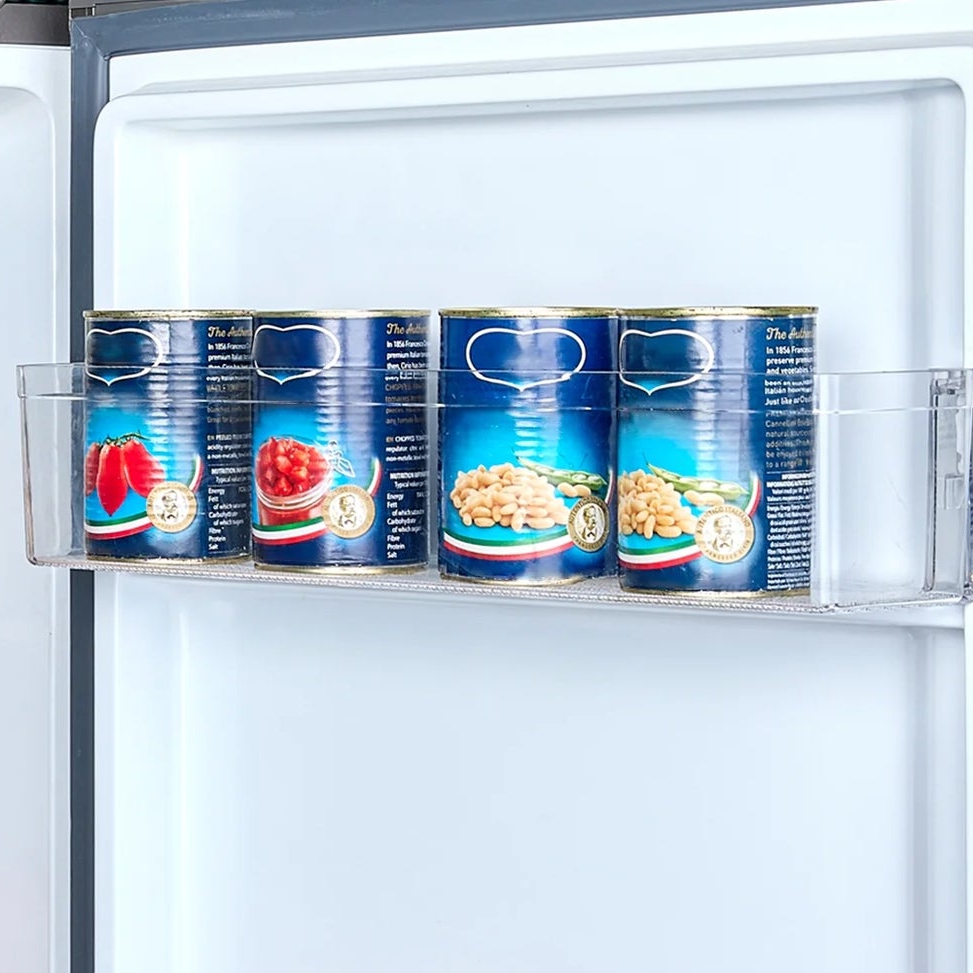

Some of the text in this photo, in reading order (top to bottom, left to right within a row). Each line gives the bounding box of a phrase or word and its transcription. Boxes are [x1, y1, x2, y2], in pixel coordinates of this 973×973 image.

[207, 326, 226, 338] The
[386, 322, 405, 335] The
[766, 327, 787, 340] The
[766, 346, 774, 354] In
[766, 358, 795, 366] preserve
[765, 398, 780, 406] Just
